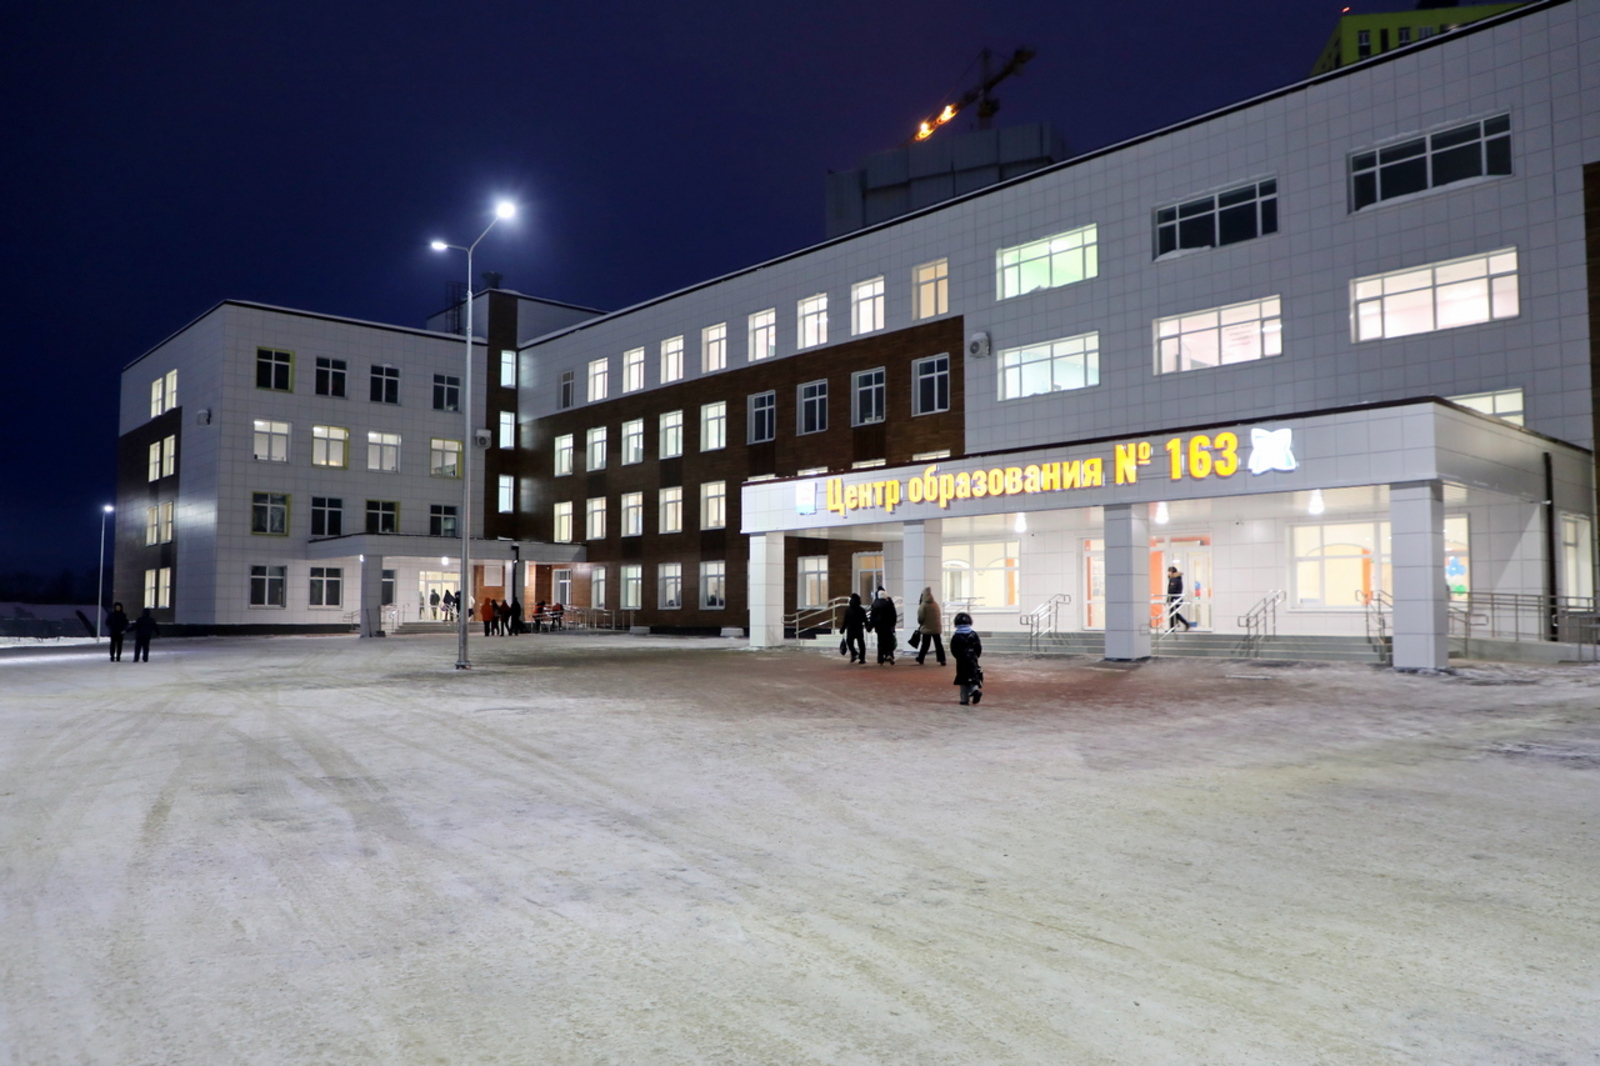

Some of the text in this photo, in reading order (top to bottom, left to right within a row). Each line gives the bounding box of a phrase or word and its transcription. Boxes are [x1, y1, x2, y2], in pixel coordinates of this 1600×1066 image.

[827, 431, 1239, 516] Центр образования № 163
